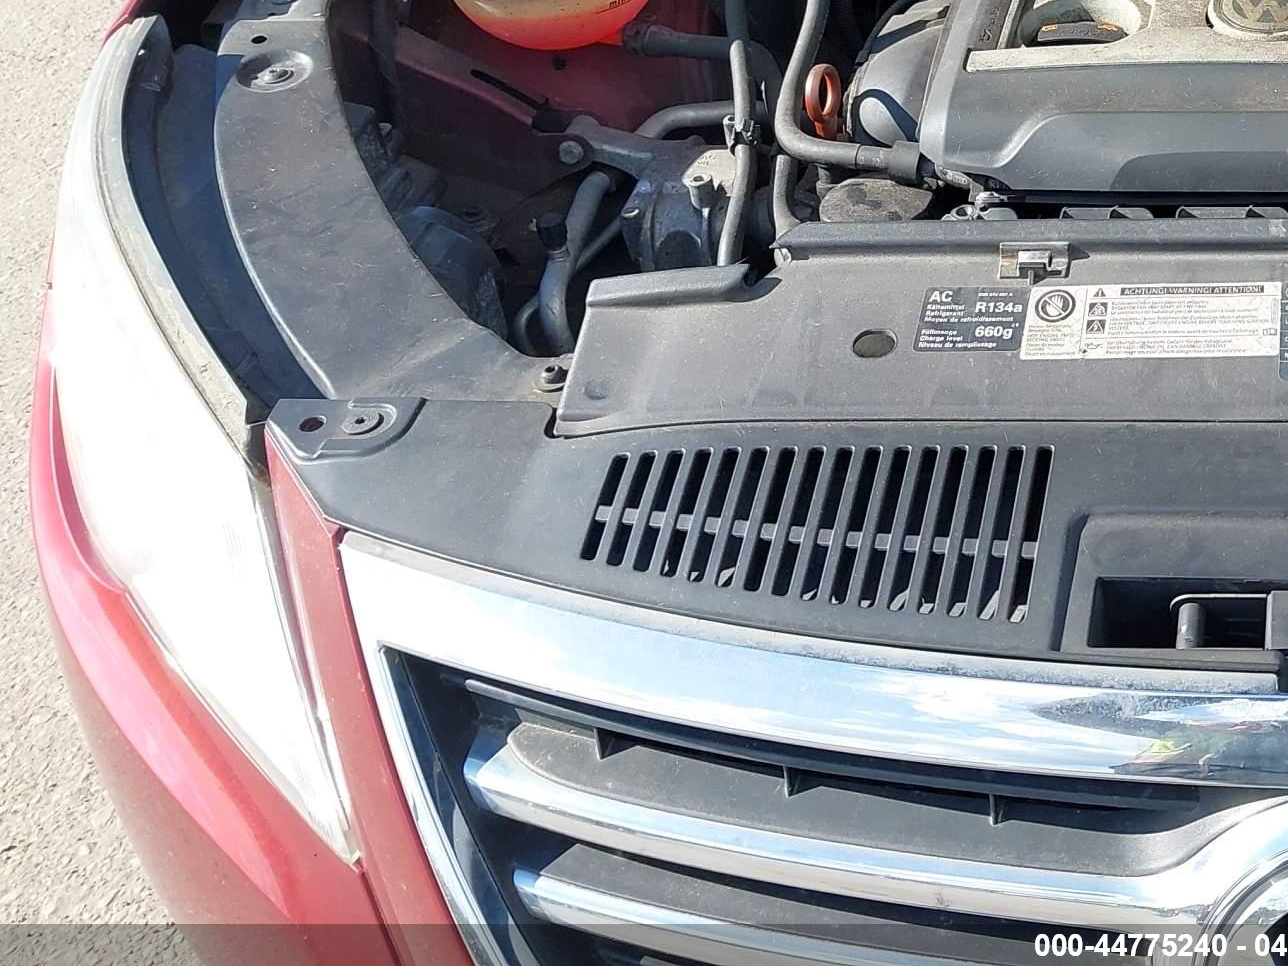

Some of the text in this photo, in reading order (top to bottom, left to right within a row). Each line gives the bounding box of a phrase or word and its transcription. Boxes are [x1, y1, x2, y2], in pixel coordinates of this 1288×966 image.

[929, 290, 953, 302] AC
[975, 301, 1023, 313] R134a
[974, 325, 1014, 339] 660g
